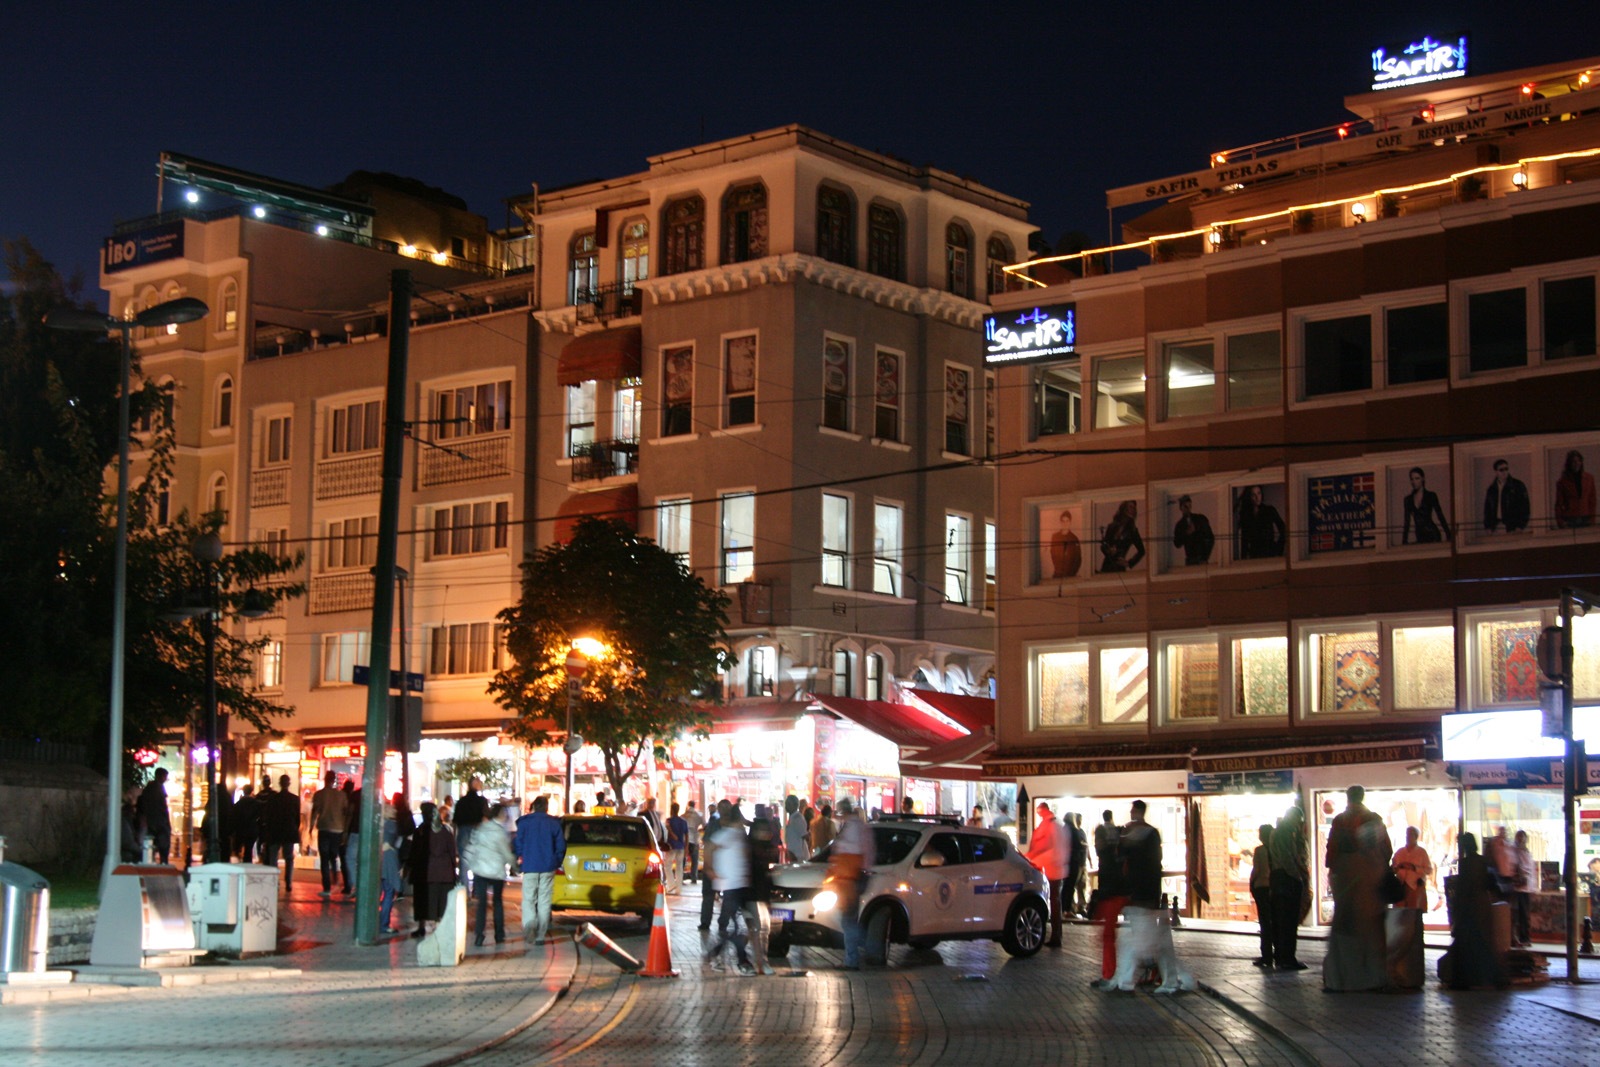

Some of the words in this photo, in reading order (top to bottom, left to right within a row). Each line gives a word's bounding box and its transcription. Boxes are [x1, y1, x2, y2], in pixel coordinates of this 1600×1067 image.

[1376, 134, 1402, 149] CAFE
[1418, 117, 1487, 140] RESTAURANT
[1216, 160, 1279, 182] TERAS
[999, 763, 1039, 776] YURDAN
[1044, 761, 1085, 775] CARPET
[1089, 762, 1098, 772] &
[1104, 759, 1166, 773] JEWELLERY
[1211, 757, 1256, 771] YURDAN
[1263, 754, 1307, 768] CARPET
[1314, 753, 1324, 763] &
[1330, 747, 1400, 763] JEWELLERY
[1469, 769, 1489, 780] flight
